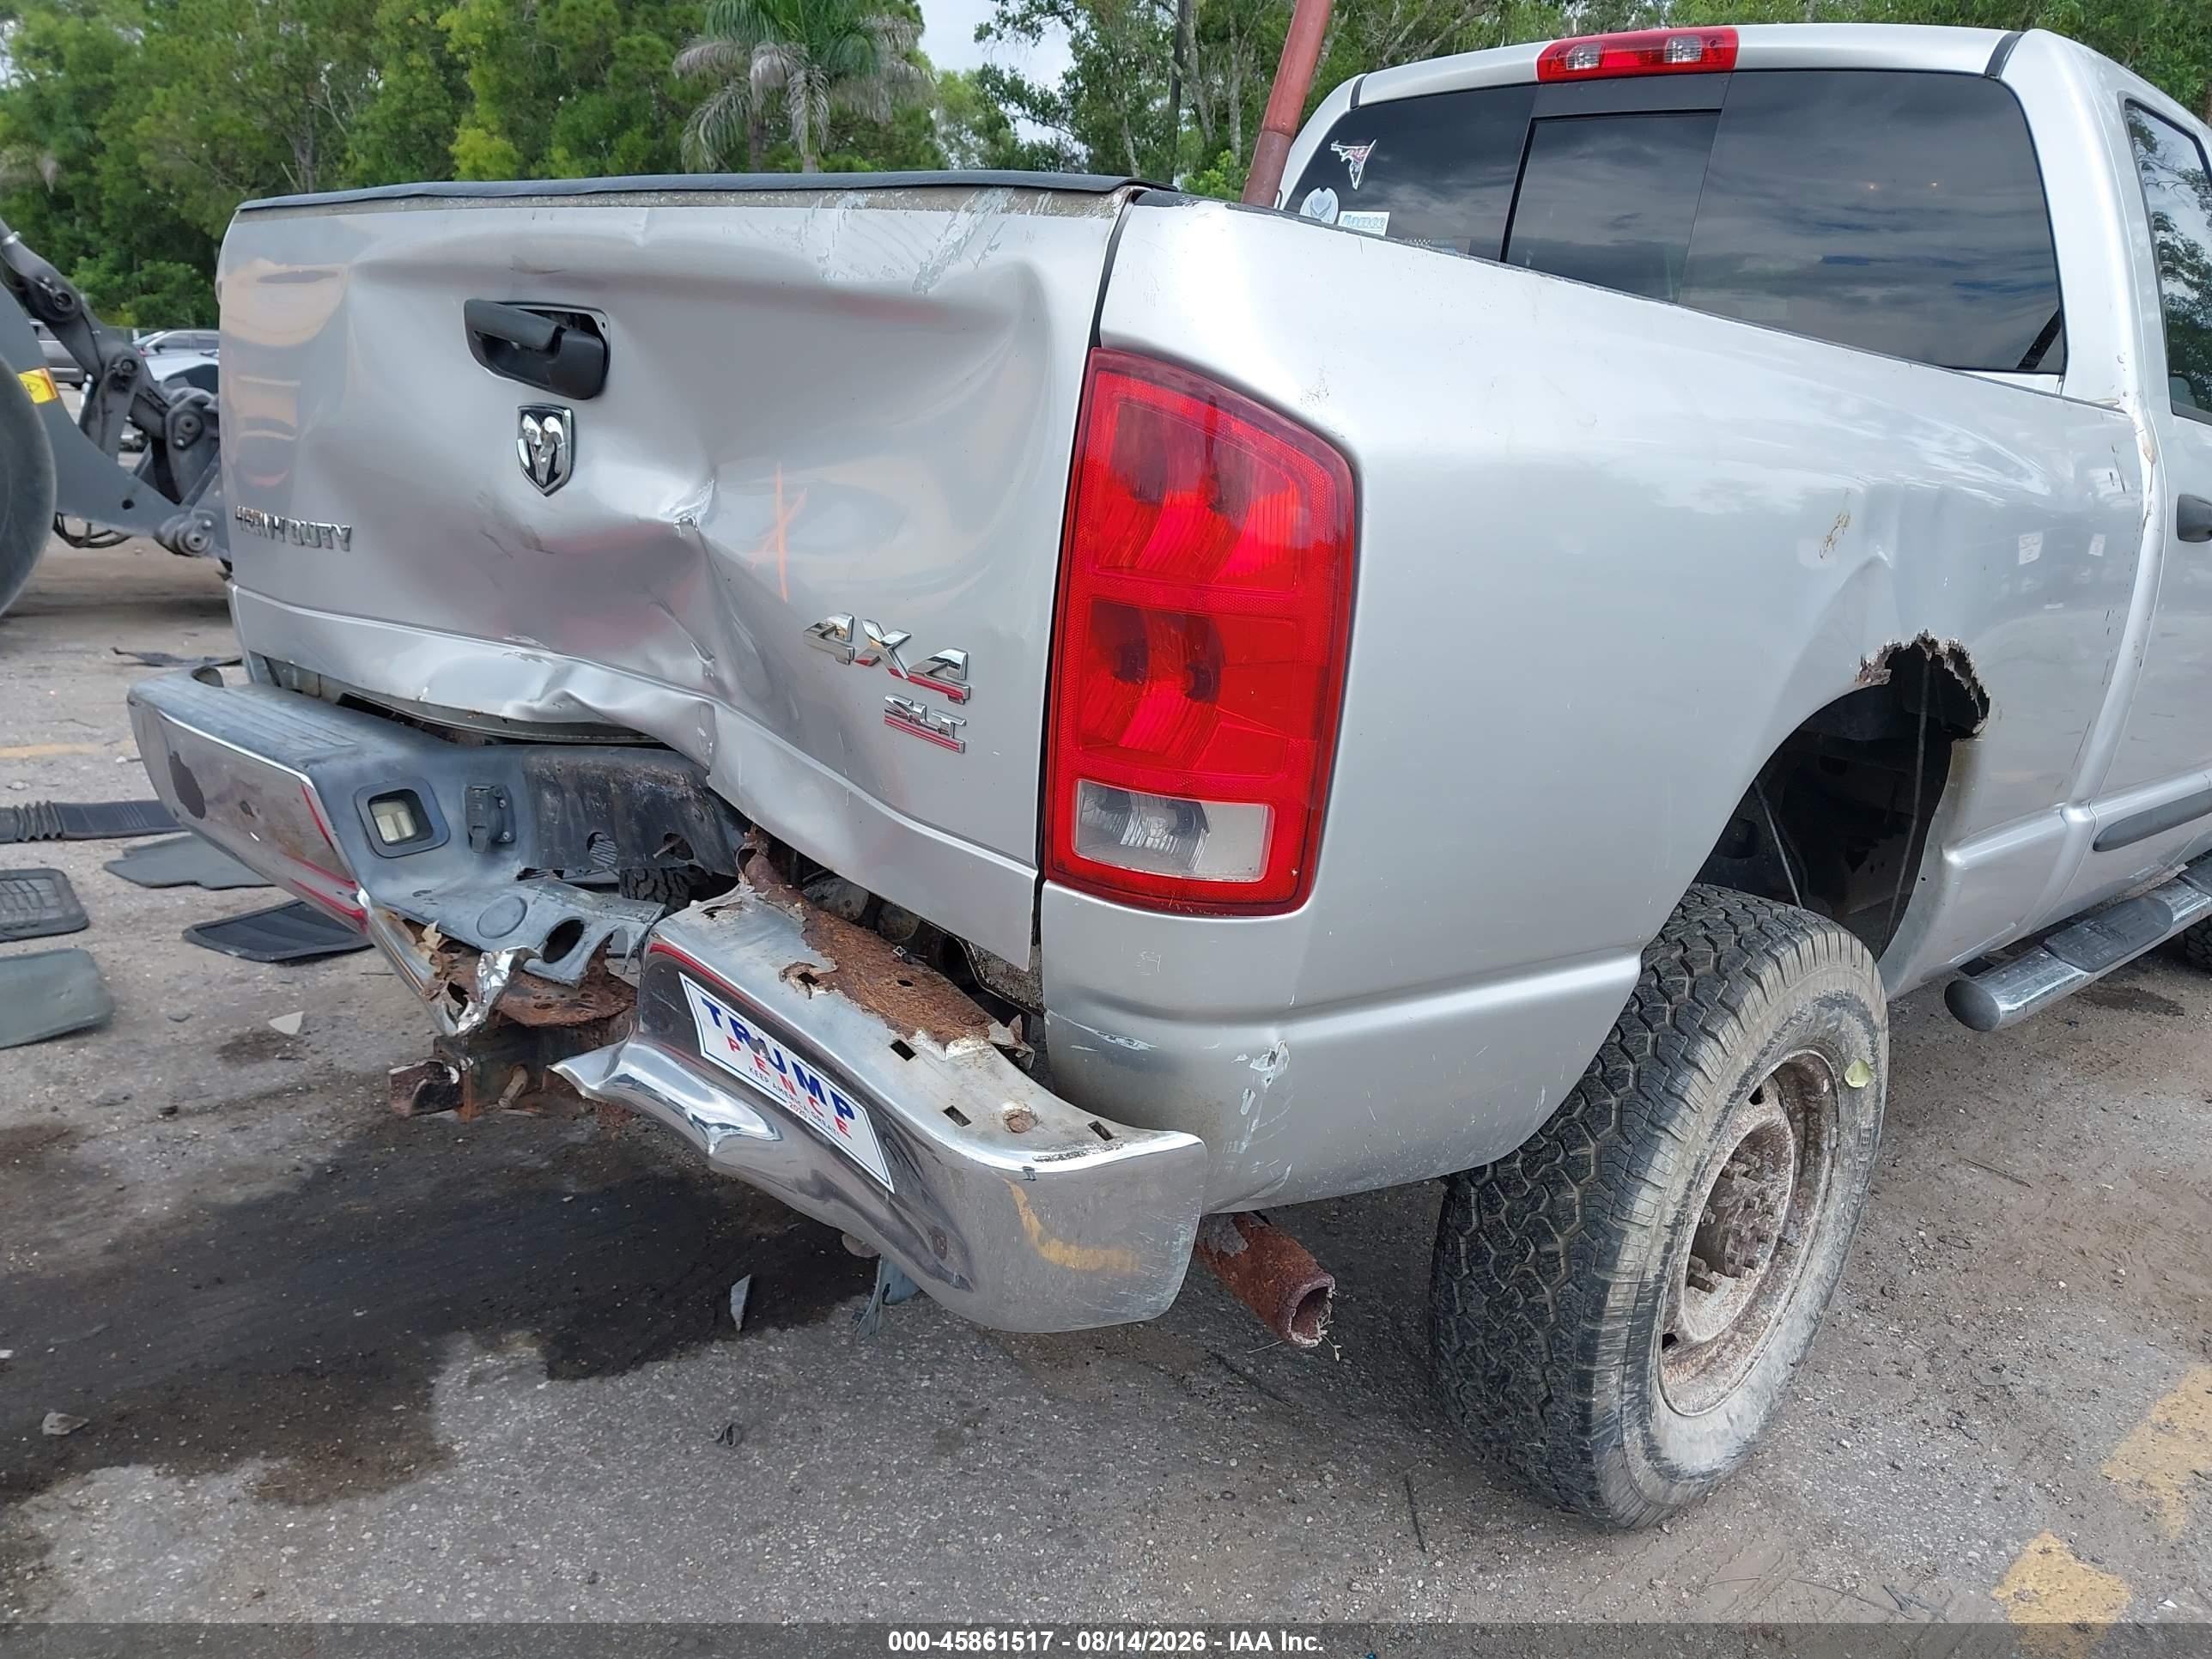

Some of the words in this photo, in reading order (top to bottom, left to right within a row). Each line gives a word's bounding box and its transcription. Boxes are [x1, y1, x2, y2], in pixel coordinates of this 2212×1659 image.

[286, 518, 353, 552] DUTY
[883, 694, 967, 740] SLT
[700, 996, 855, 1121] TRUMP
[748, 1066, 769, 1084] KEEP
[726, 1036, 853, 1139] PENCE
